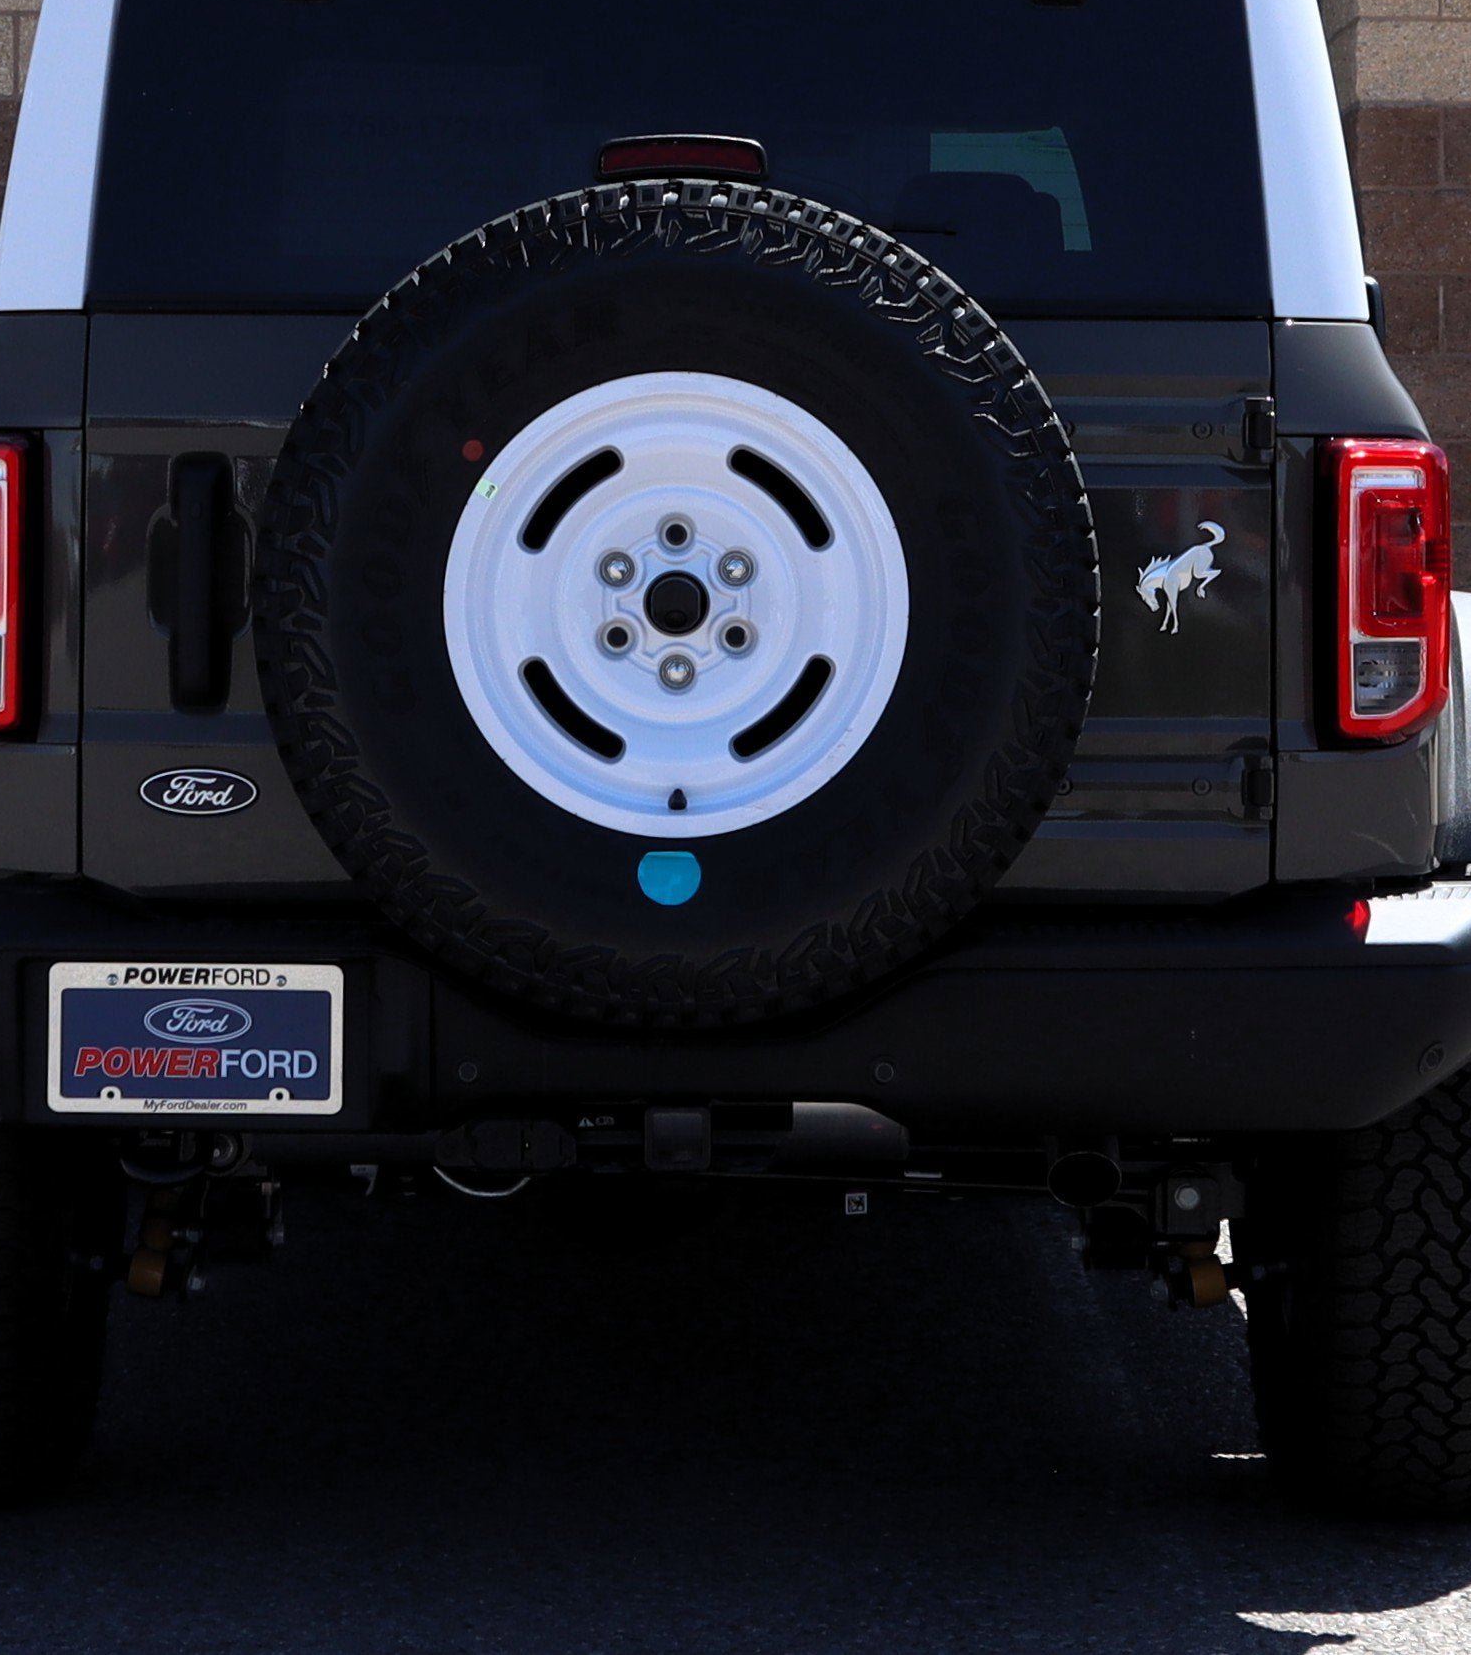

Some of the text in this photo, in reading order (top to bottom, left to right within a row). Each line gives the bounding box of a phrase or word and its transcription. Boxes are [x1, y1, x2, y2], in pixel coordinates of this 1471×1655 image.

[161, 775, 234, 808] Ford
[123, 967, 271, 986] POWERFORD
[165, 1005, 229, 1034] Ford
[73, 1046, 318, 1079] POWERFORD
[142, 1099, 248, 1113] MyFordDealer.com
